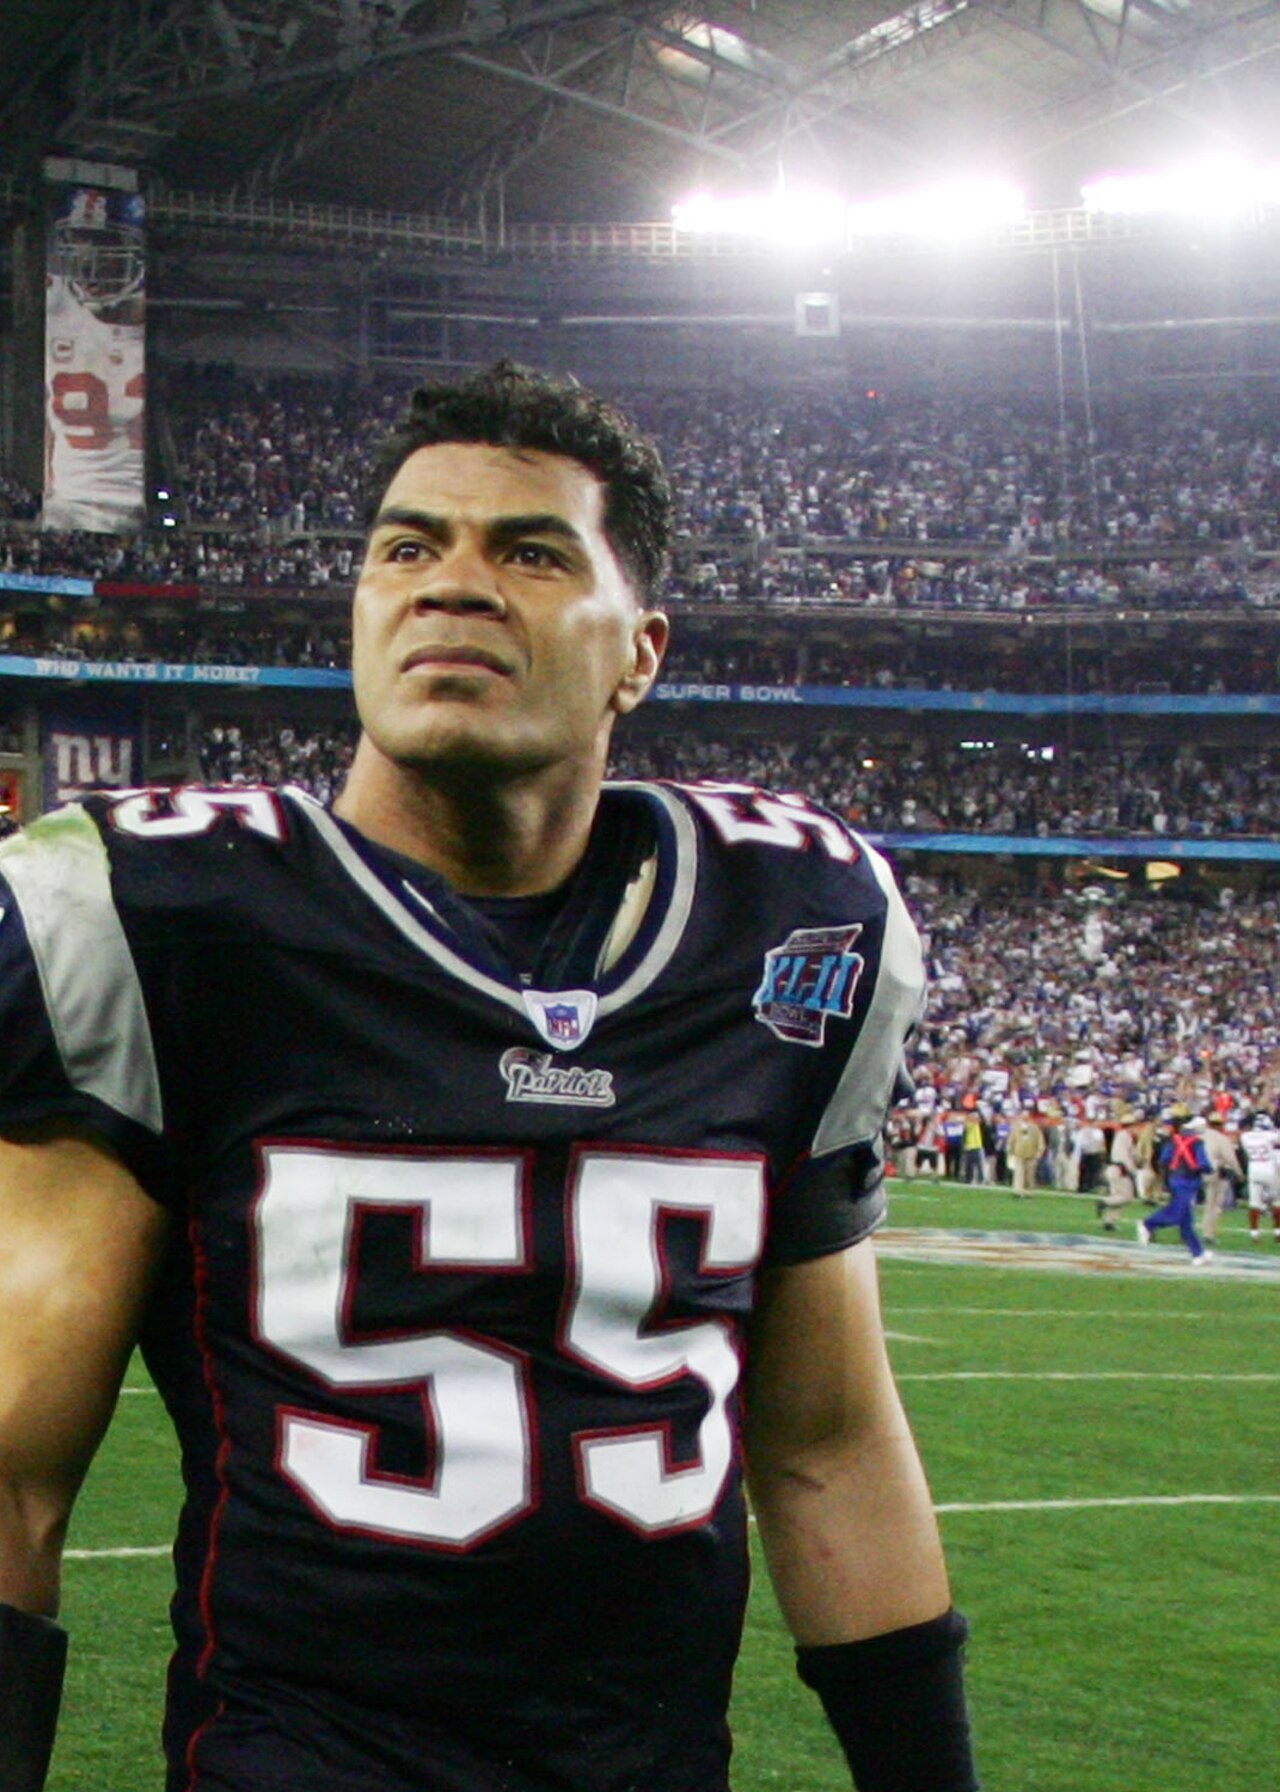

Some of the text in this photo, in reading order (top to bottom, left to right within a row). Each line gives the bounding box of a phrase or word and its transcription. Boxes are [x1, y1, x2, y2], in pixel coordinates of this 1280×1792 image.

[34, 658, 261, 682] WHO WANTS IT MORE?
[655, 683, 803, 703] SUPER BOWL
[505, 1060, 617, 1108] Patriots
[249, 1137, 769, 1555] 55
